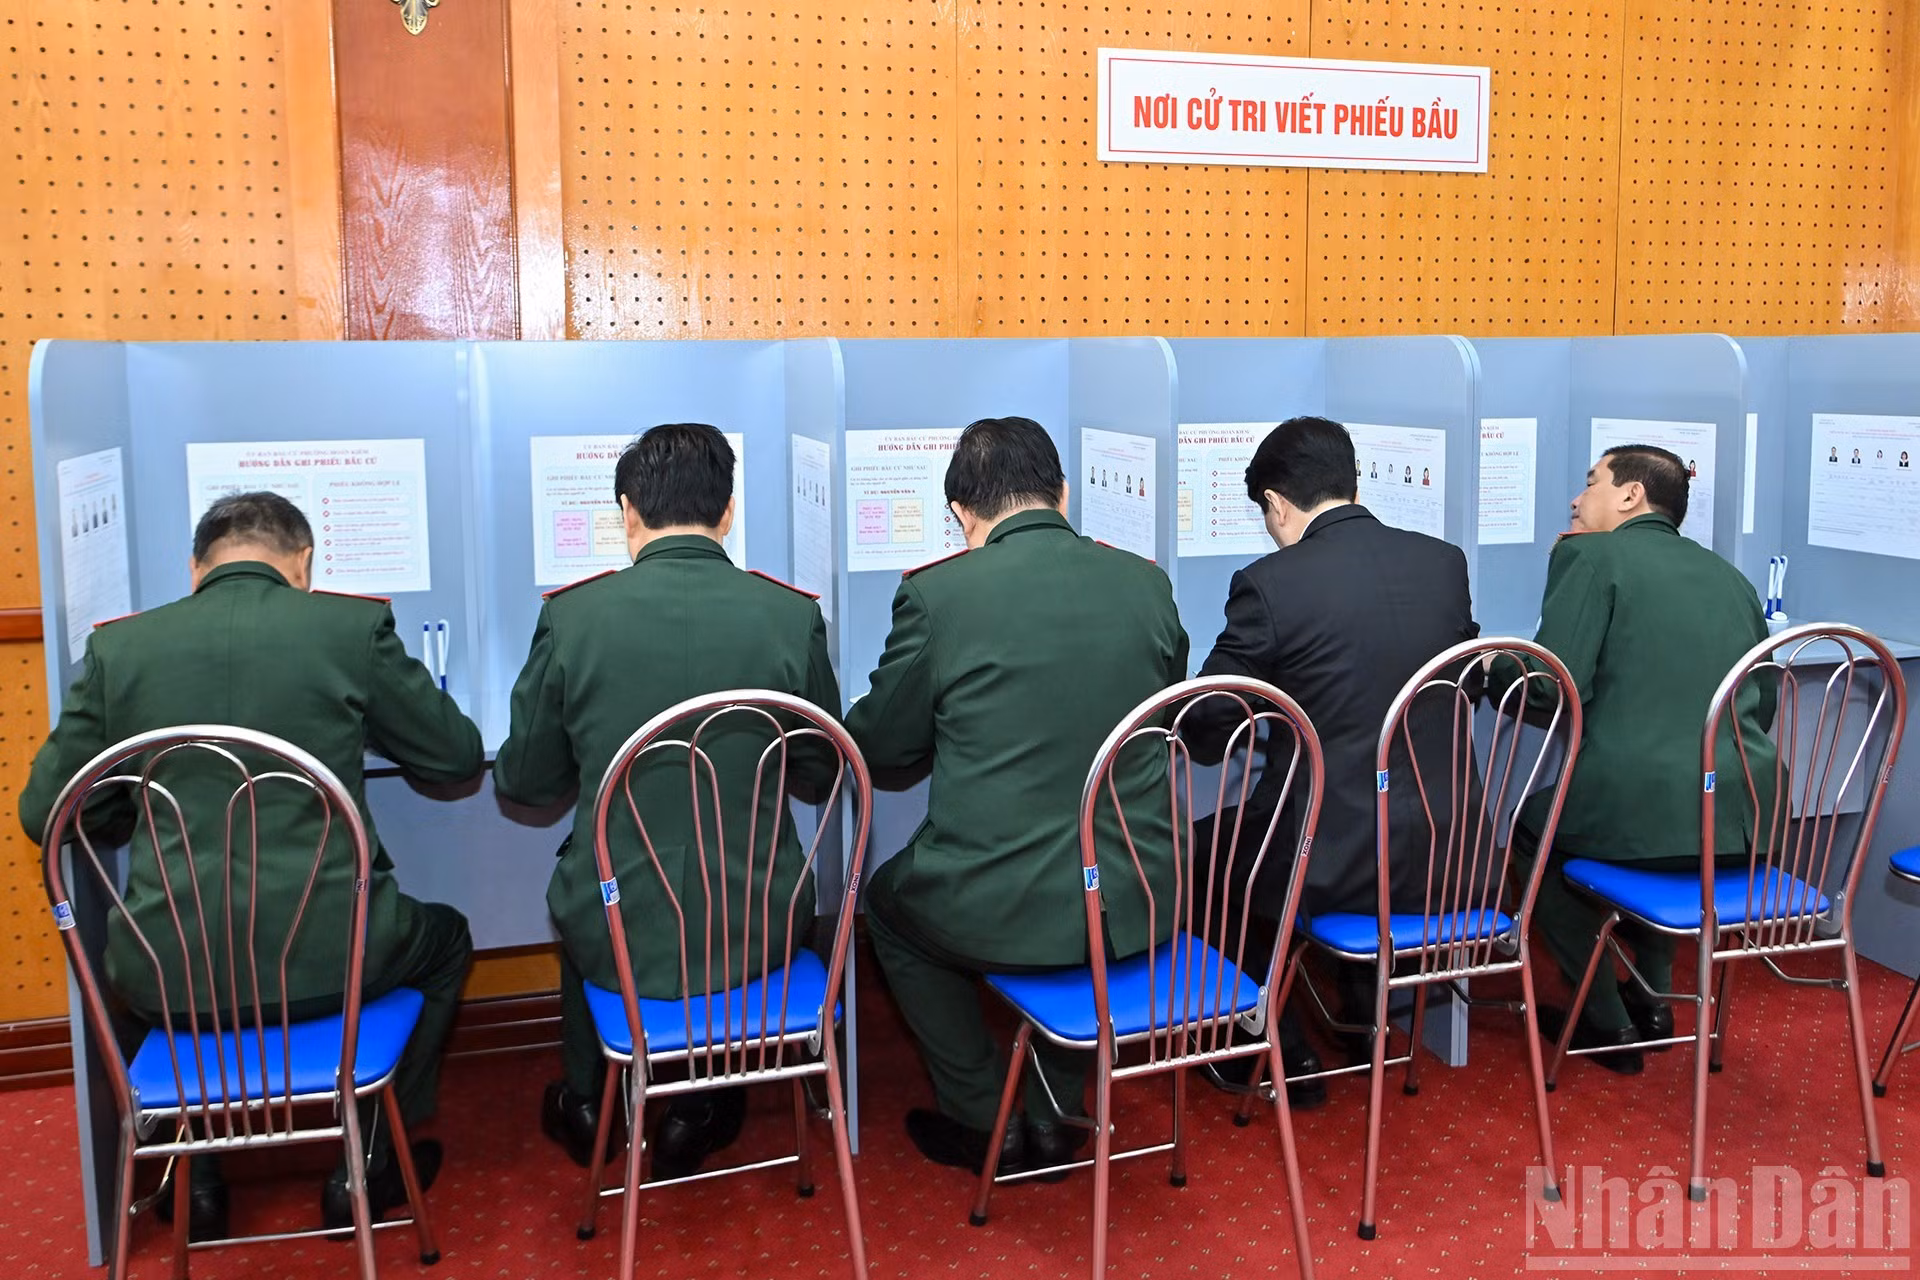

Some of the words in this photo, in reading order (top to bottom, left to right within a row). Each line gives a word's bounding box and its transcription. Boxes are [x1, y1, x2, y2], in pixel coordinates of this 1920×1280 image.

[1134, 94, 1178, 129] NƠI
[1187, 88, 1222, 130] CỬ
[1229, 99, 1266, 132] TRI
[1275, 93, 1325, 133] VIẾT
[1334, 96, 1403, 137] PHIẾU
[1412, 97, 1458, 139] BẦU
